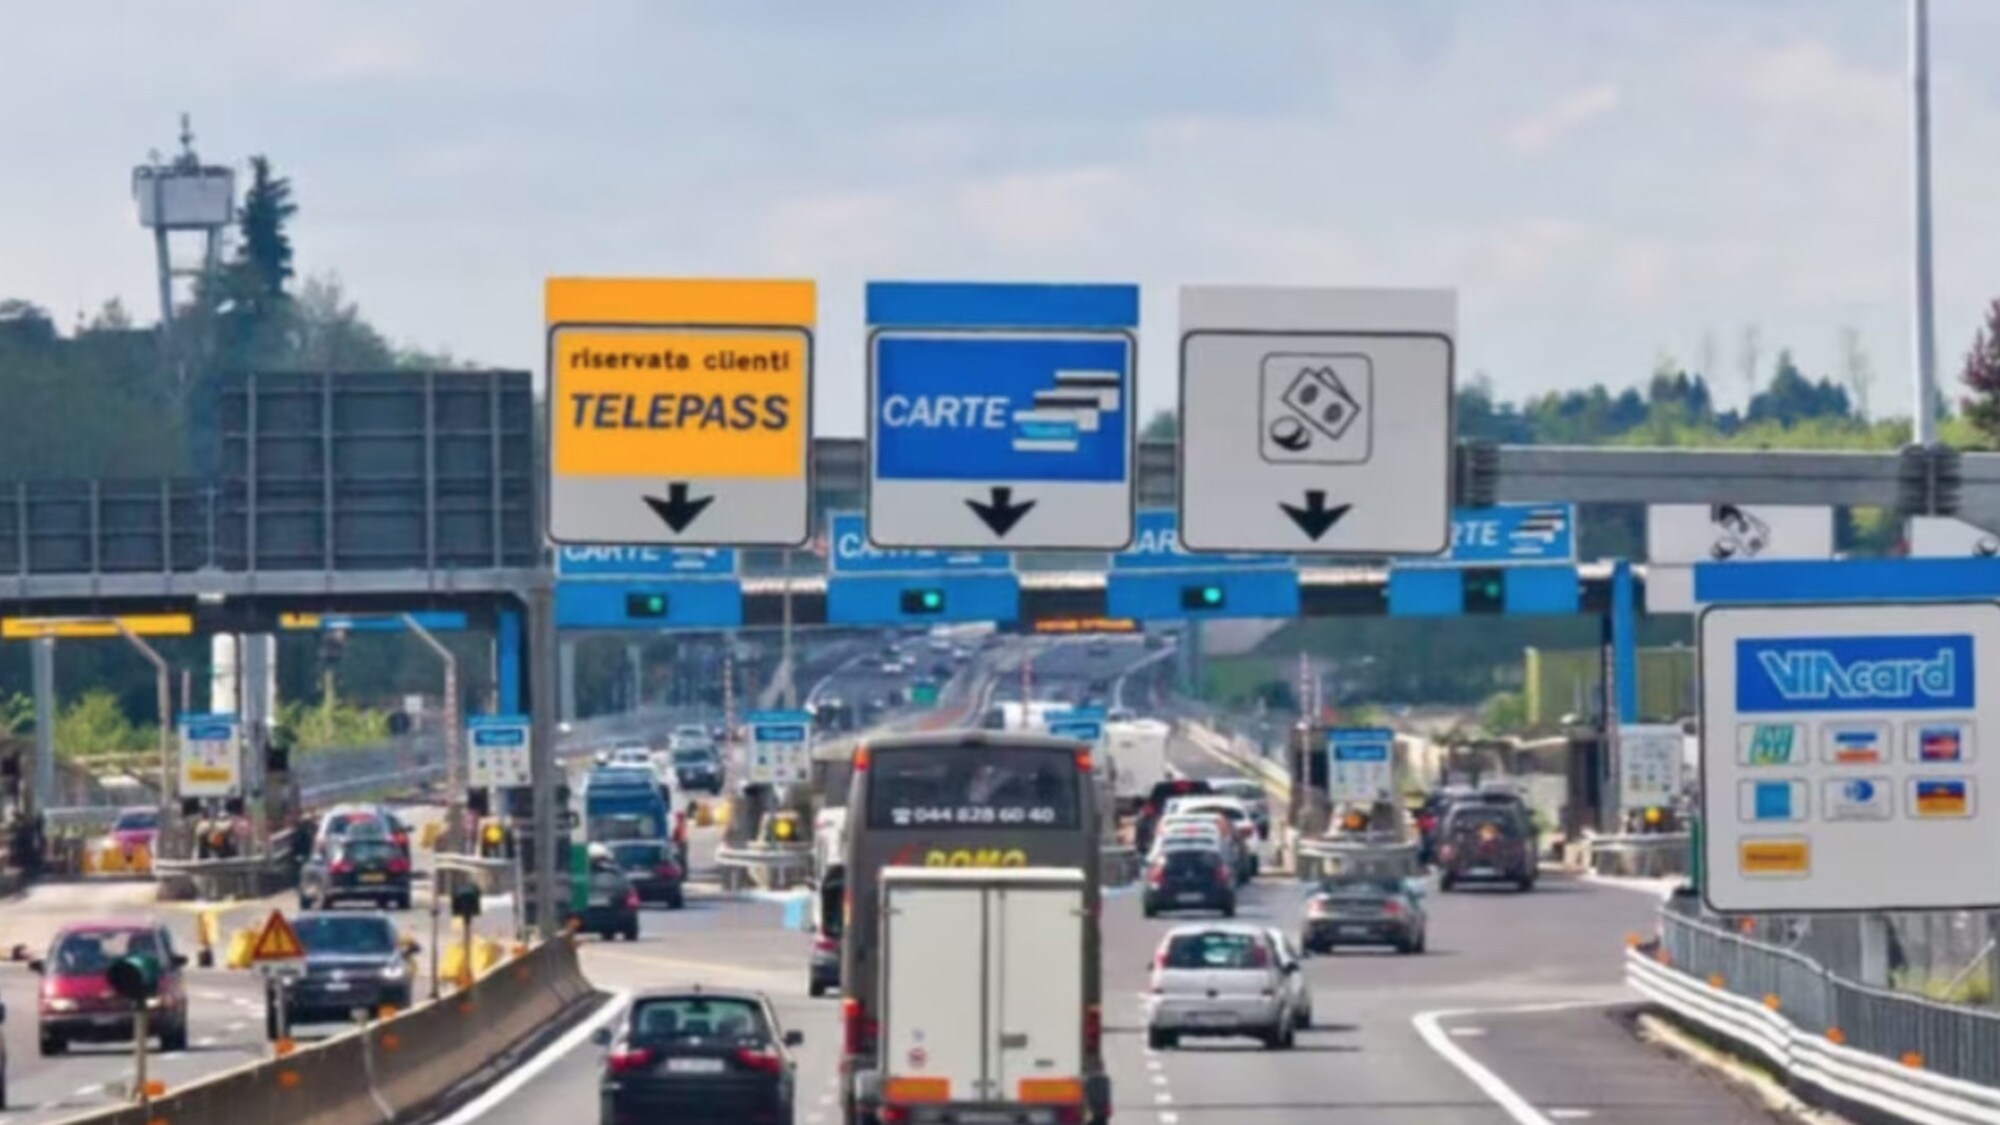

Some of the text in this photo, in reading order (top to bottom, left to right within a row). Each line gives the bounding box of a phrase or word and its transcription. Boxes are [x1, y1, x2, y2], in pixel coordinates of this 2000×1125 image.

[570, 349, 790, 371] riservata clienti
[570, 393, 790, 430] TELEPASS
[882, 394, 1010, 429] CARTE
